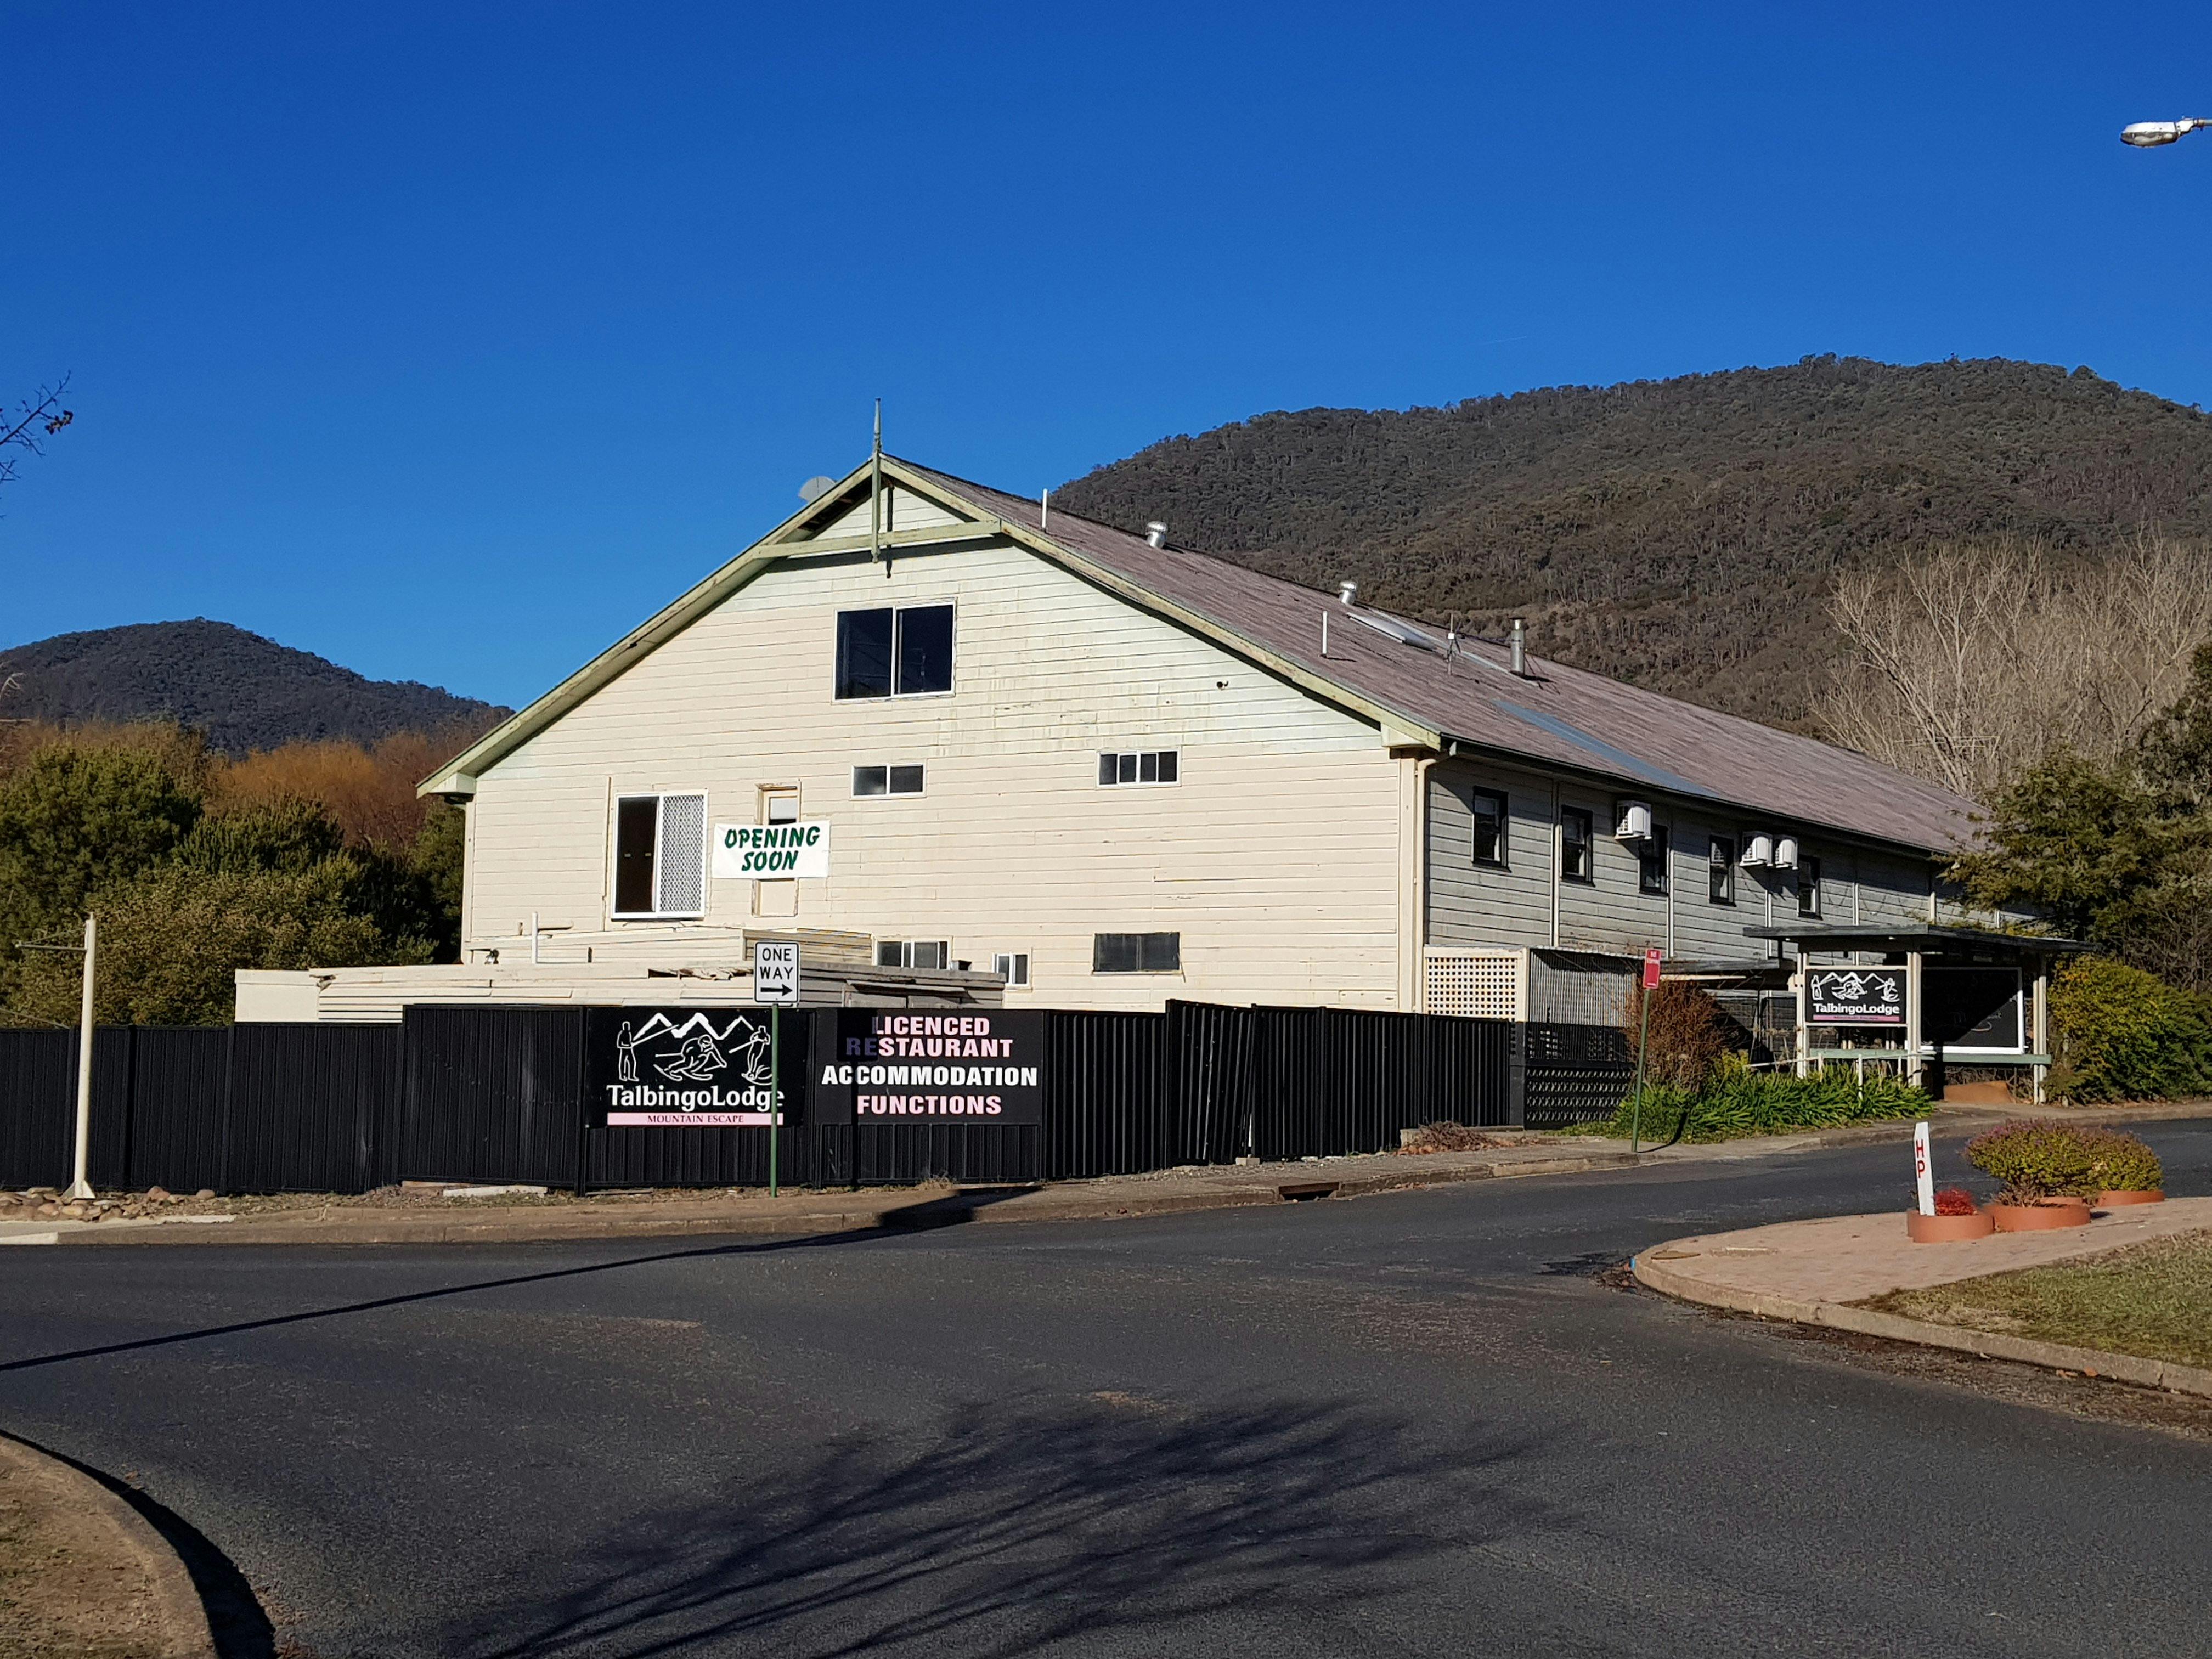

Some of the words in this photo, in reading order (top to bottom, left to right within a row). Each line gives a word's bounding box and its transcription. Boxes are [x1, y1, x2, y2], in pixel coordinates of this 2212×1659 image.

[724, 826, 820, 849] OPENING
[741, 850, 799, 871] SOON
[763, 948, 792, 961] ONE
[760, 966, 793, 980] WAY
[1813, 1003, 1900, 1015] TalbingoLodge
[872, 1017, 990, 1036] LICENCED
[846, 1038, 1013, 1057] RESTAURANT
[822, 1065, 1037, 1086] ACCOMMODATION
[857, 1095, 1002, 1115] FUNCTIONS
